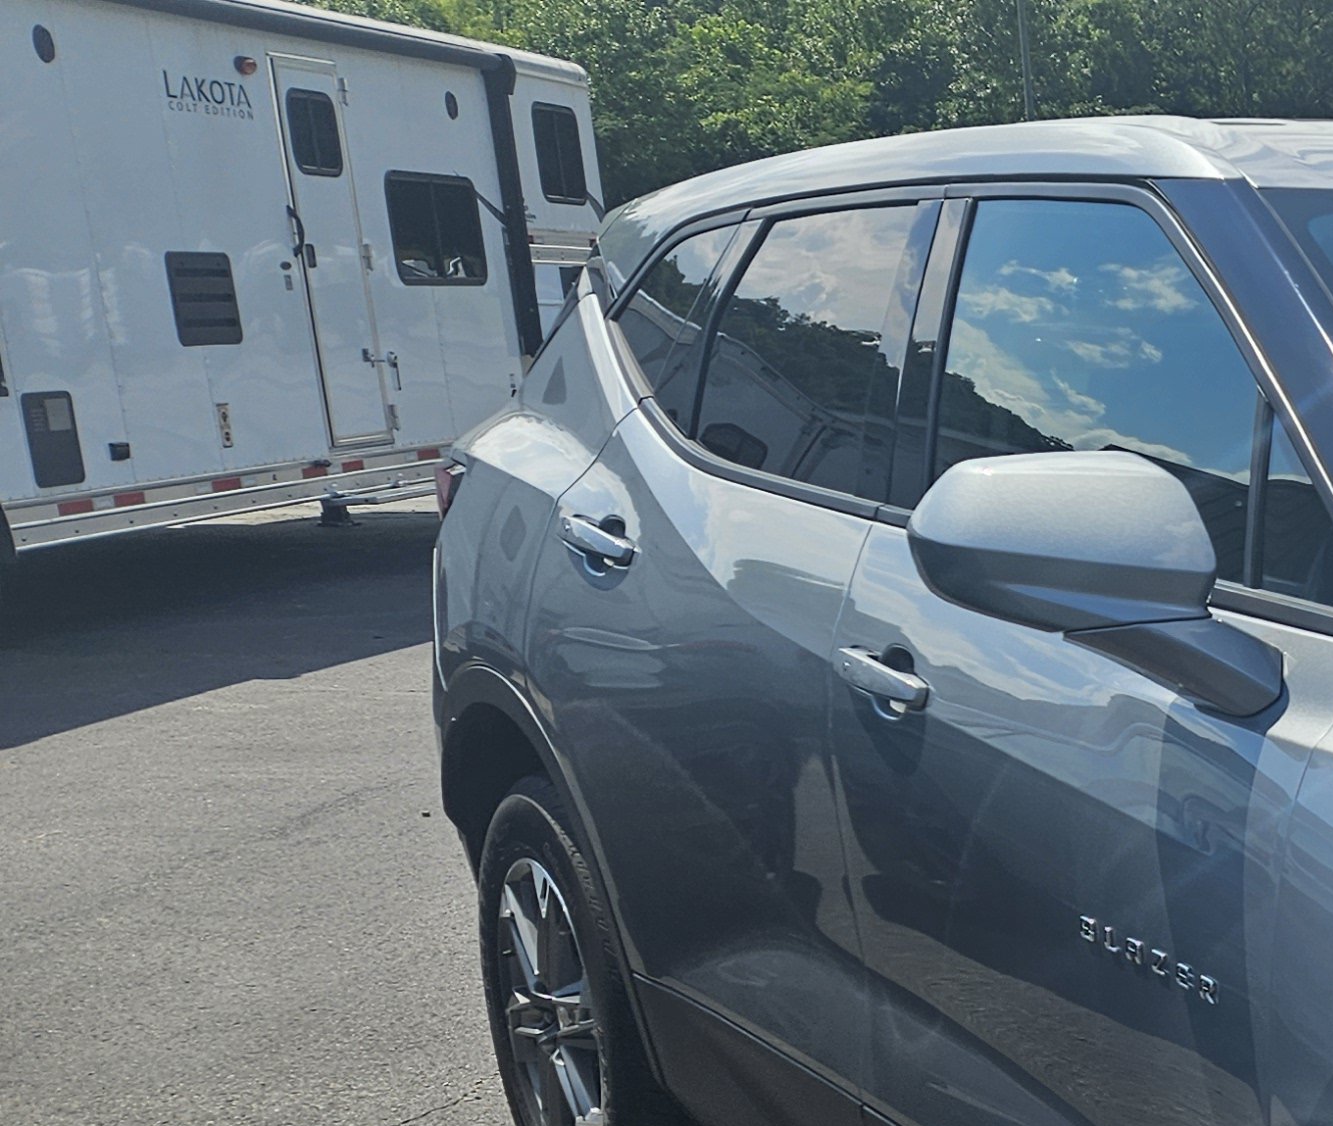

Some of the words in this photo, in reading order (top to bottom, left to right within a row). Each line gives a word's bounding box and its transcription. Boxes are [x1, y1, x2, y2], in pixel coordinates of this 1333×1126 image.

[163, 70, 252, 109] LAKOTA
[168, 100, 198, 113] COLT
[204, 104, 254, 121] EDITION
[1079, 915, 1220, 1005] BLAZER
